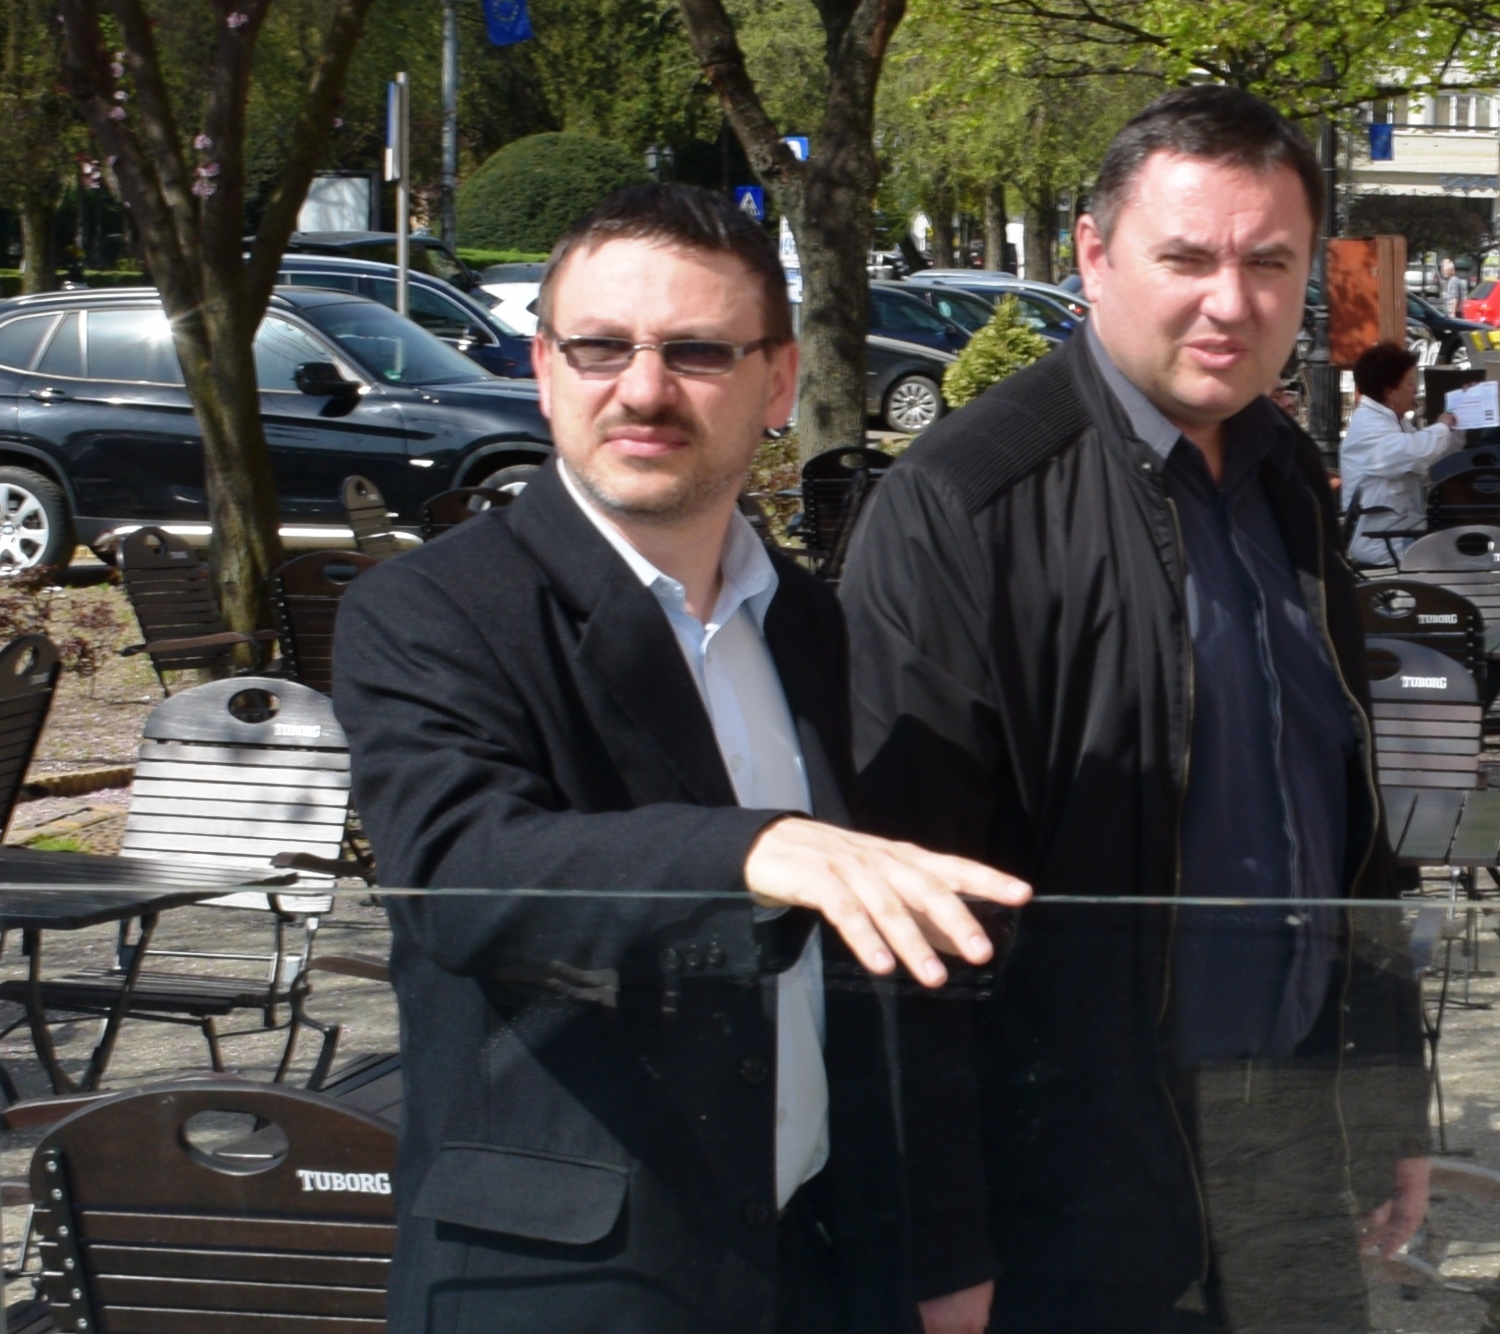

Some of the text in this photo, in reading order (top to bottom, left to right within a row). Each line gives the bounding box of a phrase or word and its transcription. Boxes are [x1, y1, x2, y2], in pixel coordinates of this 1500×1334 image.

[1418, 614, 1458, 624] TUBORG
[1401, 676, 1448, 689] TUBORG
[296, 1169, 392, 1195] TUBORG
